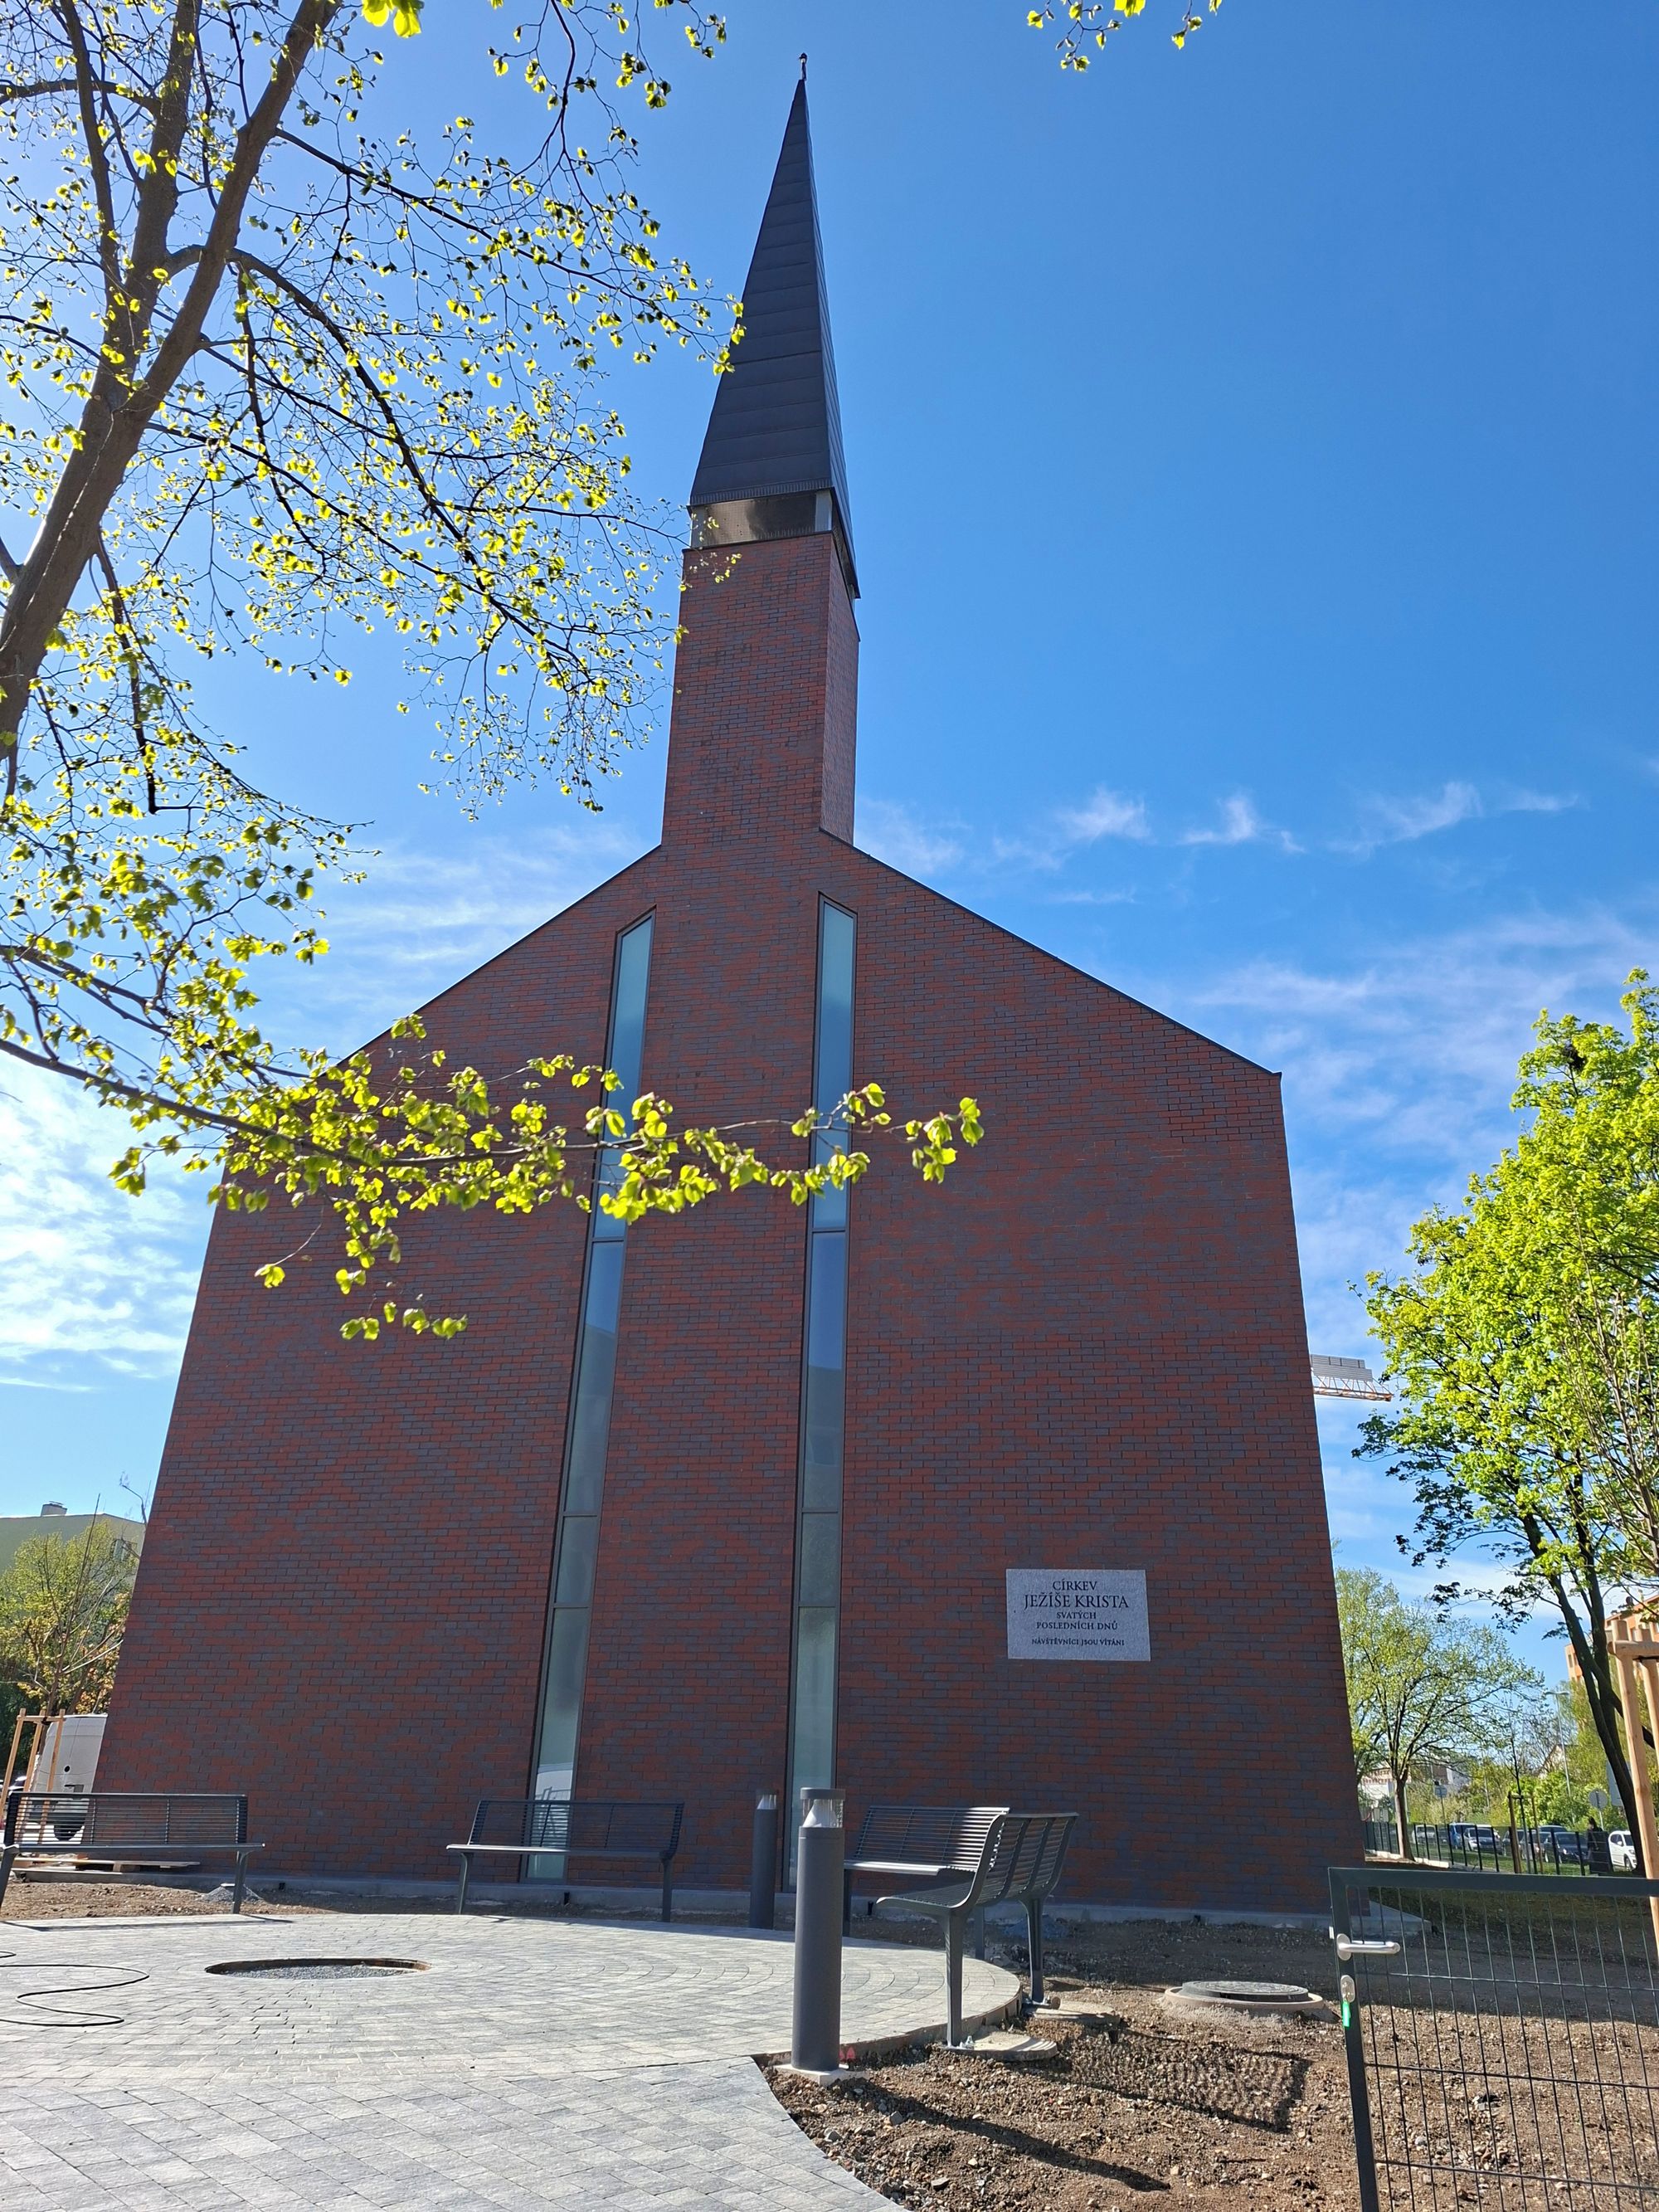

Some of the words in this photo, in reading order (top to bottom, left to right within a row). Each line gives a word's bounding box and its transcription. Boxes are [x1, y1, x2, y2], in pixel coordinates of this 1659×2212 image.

[1052, 1578, 1097, 1591] CÍRKEV
[1024, 1592, 1071, 1610] JEŽÍŠE
[1075, 1595, 1129, 1609] KRISTA
[1057, 1610, 1097, 1620] SVATÝCH
[1037, 1620, 1094, 1630] POSLEDNÍCH
[1097, 1620, 1118, 1630] DNŮ
[1031, 1636, 1078, 1646] NÁVŠTĚVNÍCI
[1081, 1639, 1098, 1647] JSOU
[1100, 1637, 1125, 1646] VÍTÁNI
